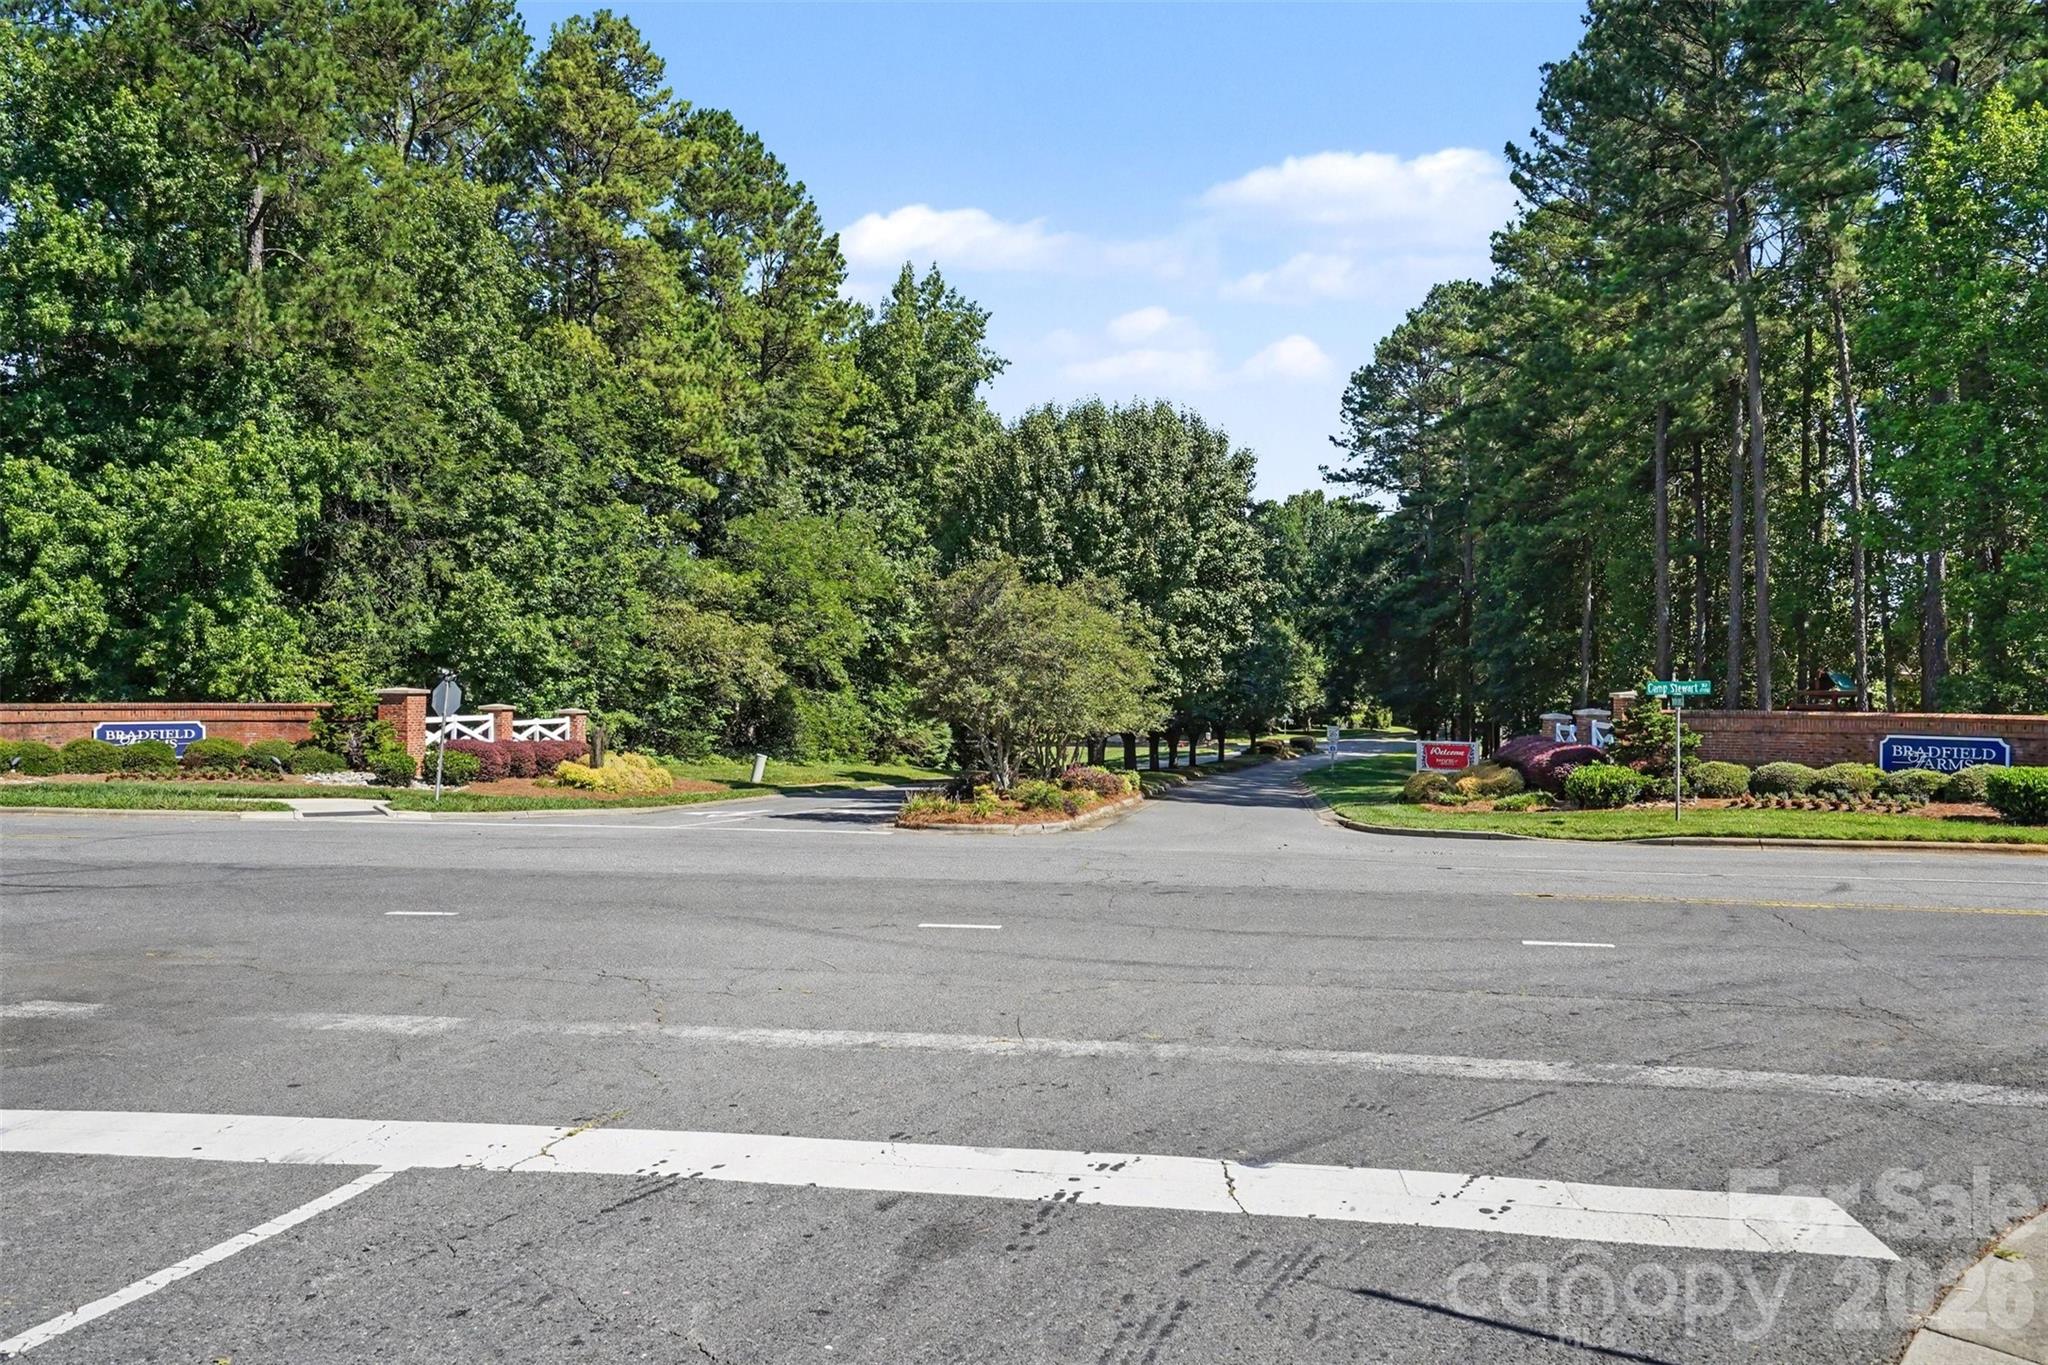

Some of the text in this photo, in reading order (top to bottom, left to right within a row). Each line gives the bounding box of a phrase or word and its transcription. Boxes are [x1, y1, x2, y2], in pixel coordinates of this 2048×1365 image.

[1647, 683, 1667, 695] Camp
[1670, 683, 1698, 694] Stewart
[105, 729, 196, 741] BRADFIELD
[1430, 747, 1465, 757] Welcome
[1891, 744, 1997, 761] BRADFIELD
